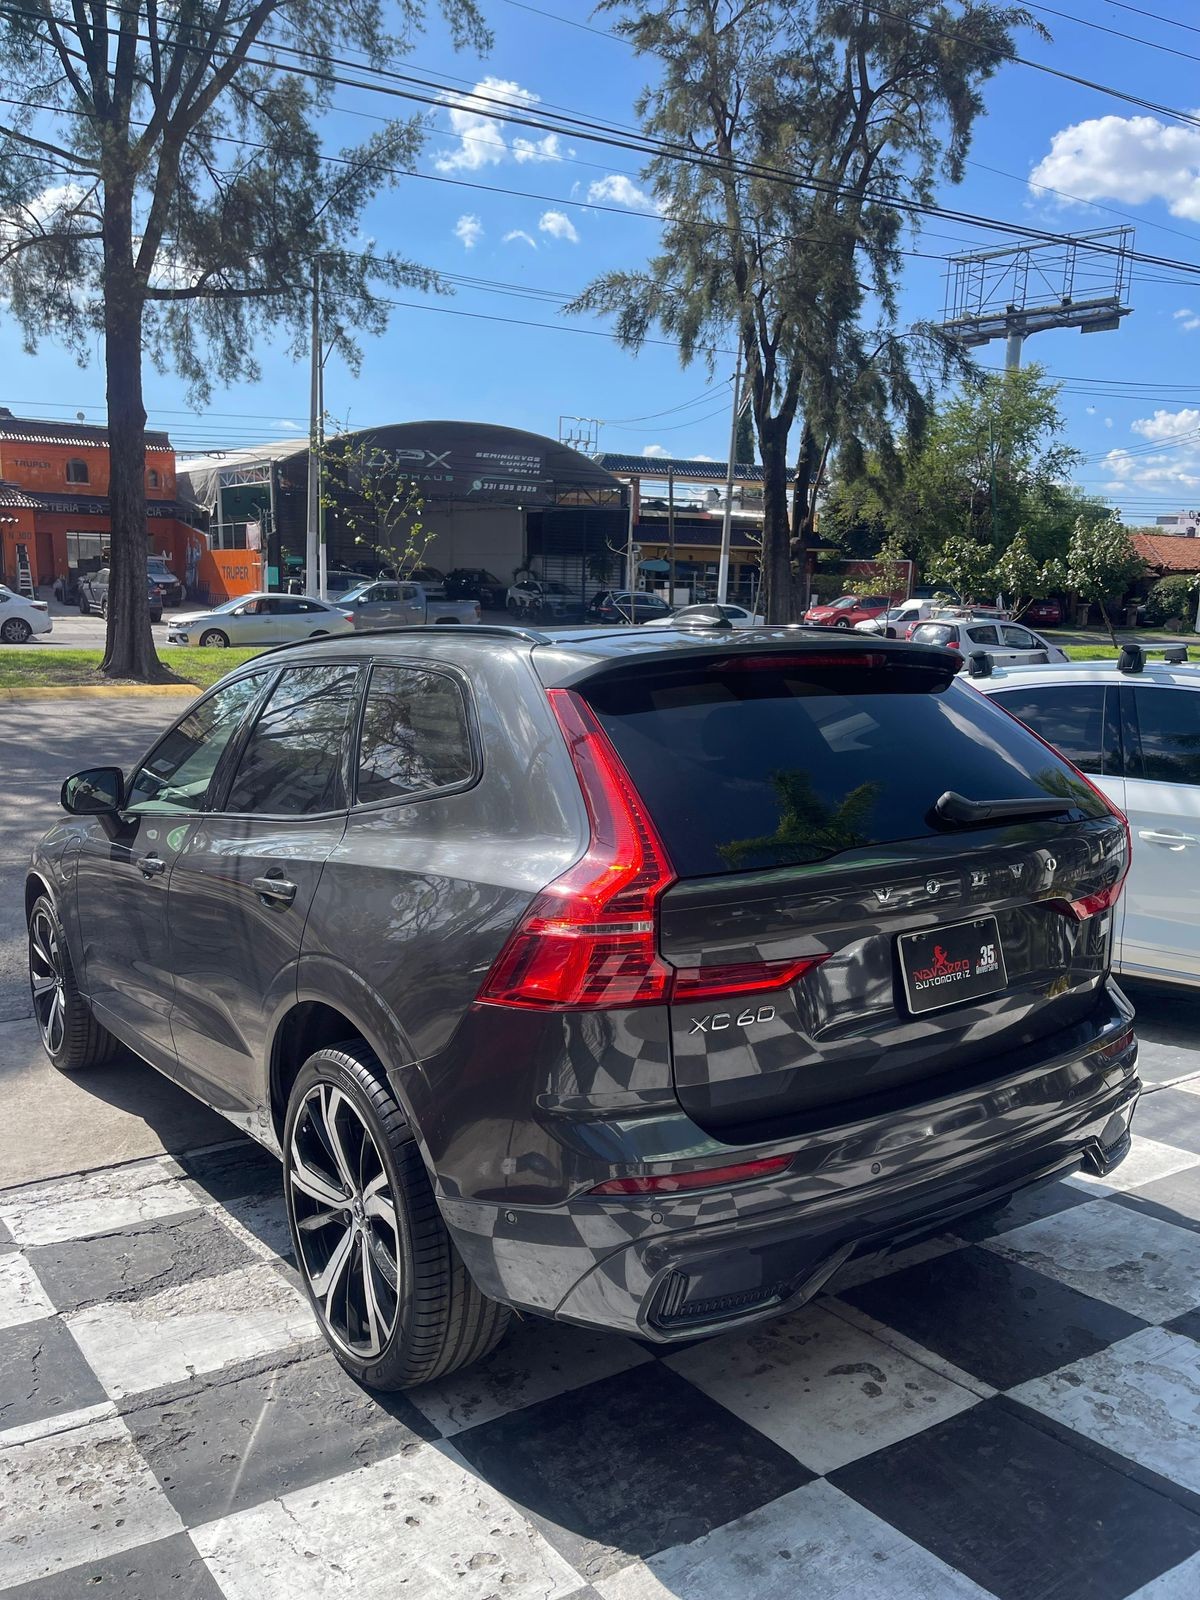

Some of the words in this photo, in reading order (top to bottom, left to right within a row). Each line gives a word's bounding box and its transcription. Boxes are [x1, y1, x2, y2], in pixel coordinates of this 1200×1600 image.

[15, 459, 51, 469] TRUPER
[475, 452, 541, 462] SEMINUEVOS
[366, 473, 454, 481] ATOHAUS
[222, 565, 249, 581] TRUPER
[873, 857, 1057, 903] VOLVO
[980, 944, 994, 966] 35
[913, 959, 970, 982] NAVARRO
[915, 969, 971, 990] AUTOMOTRIZ
